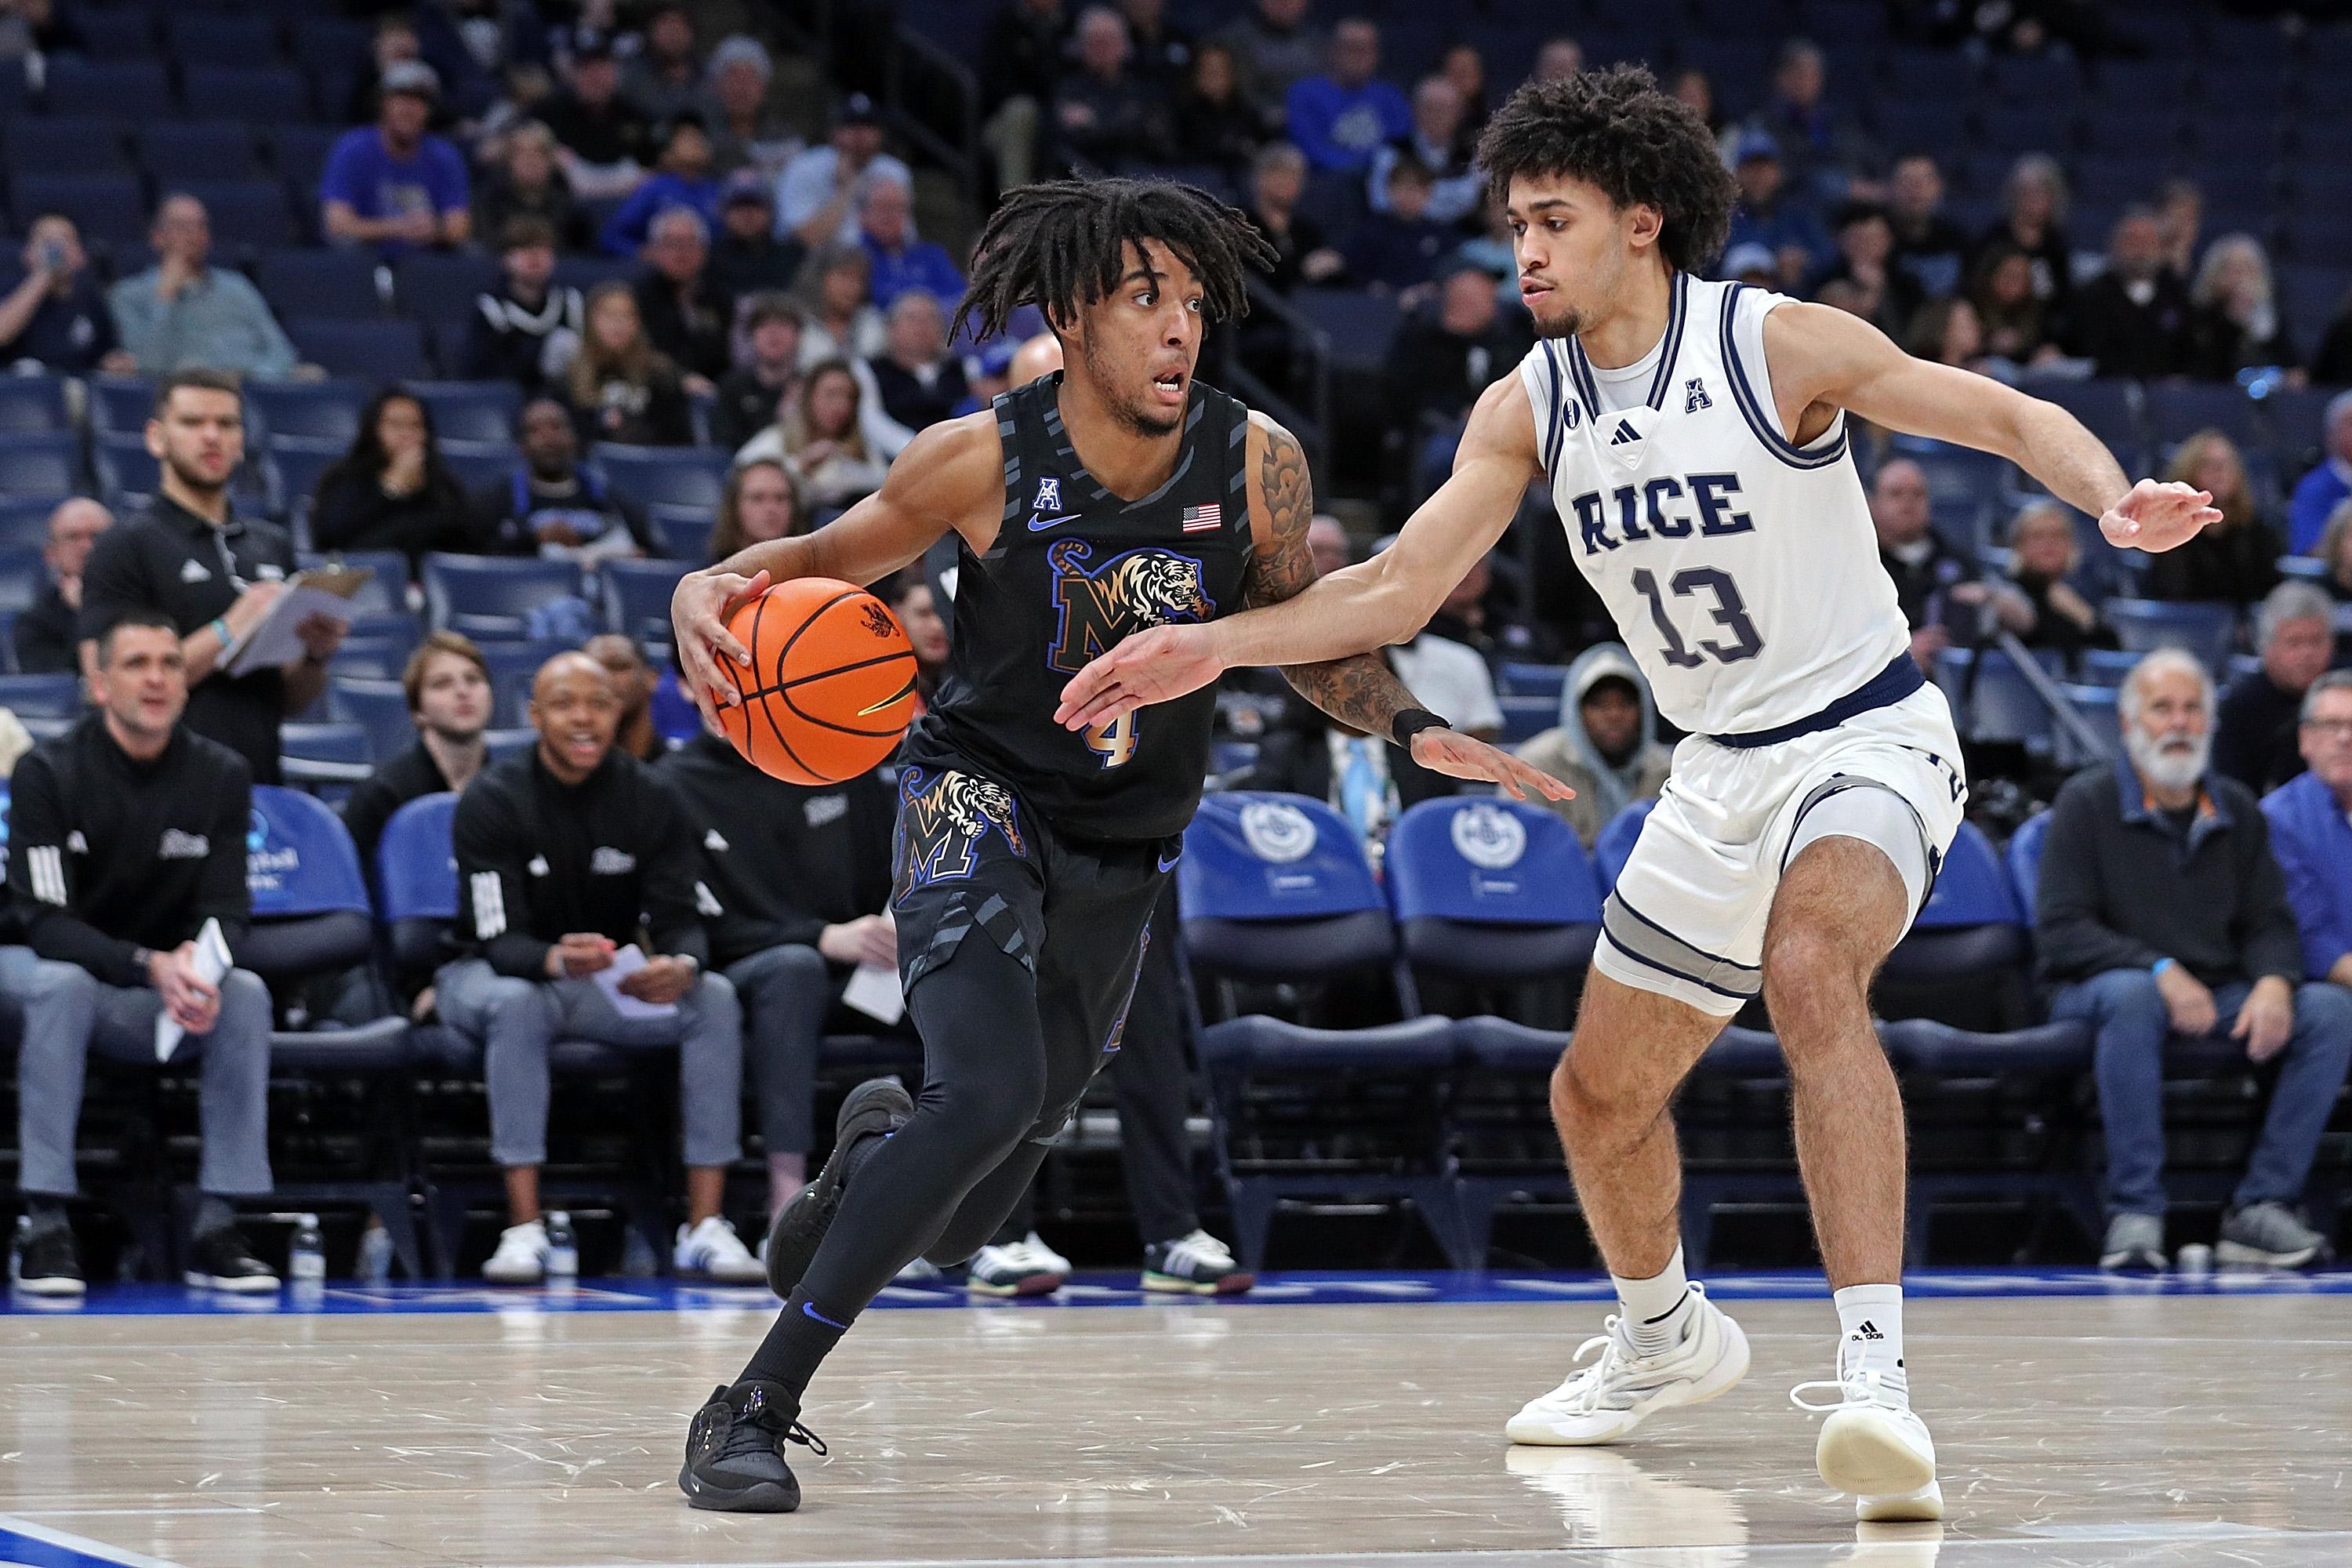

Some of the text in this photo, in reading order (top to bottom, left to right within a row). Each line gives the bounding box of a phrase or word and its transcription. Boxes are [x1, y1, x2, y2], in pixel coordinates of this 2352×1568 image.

[1571, 471, 1756, 557] RICE
[1631, 565, 1766, 669] 13
[1081, 709, 1141, 770] 4
[1851, 1332, 1884, 1341] adas
